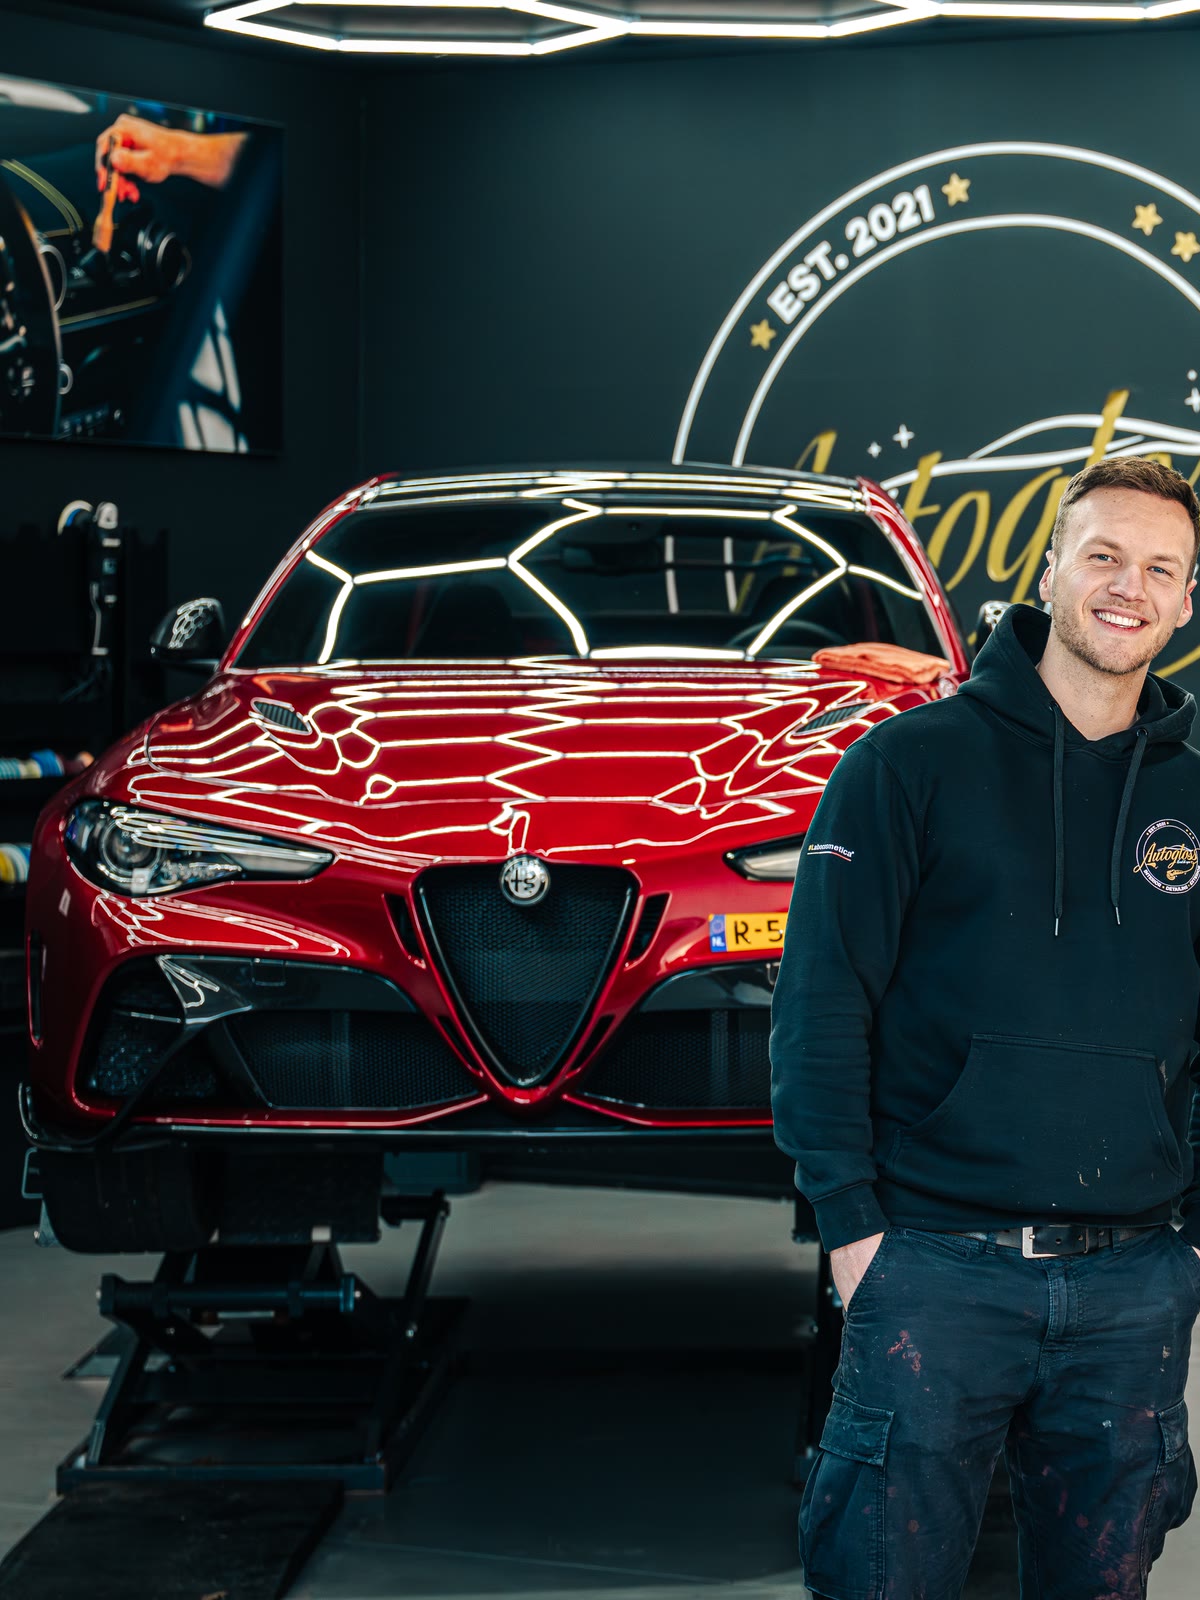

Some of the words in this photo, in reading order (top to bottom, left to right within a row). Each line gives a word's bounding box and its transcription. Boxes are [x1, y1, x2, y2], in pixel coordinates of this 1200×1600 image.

[766, 240, 850, 325] EST.
[845, 184, 935, 258] 2021
[711, 936, 725, 947] NL
